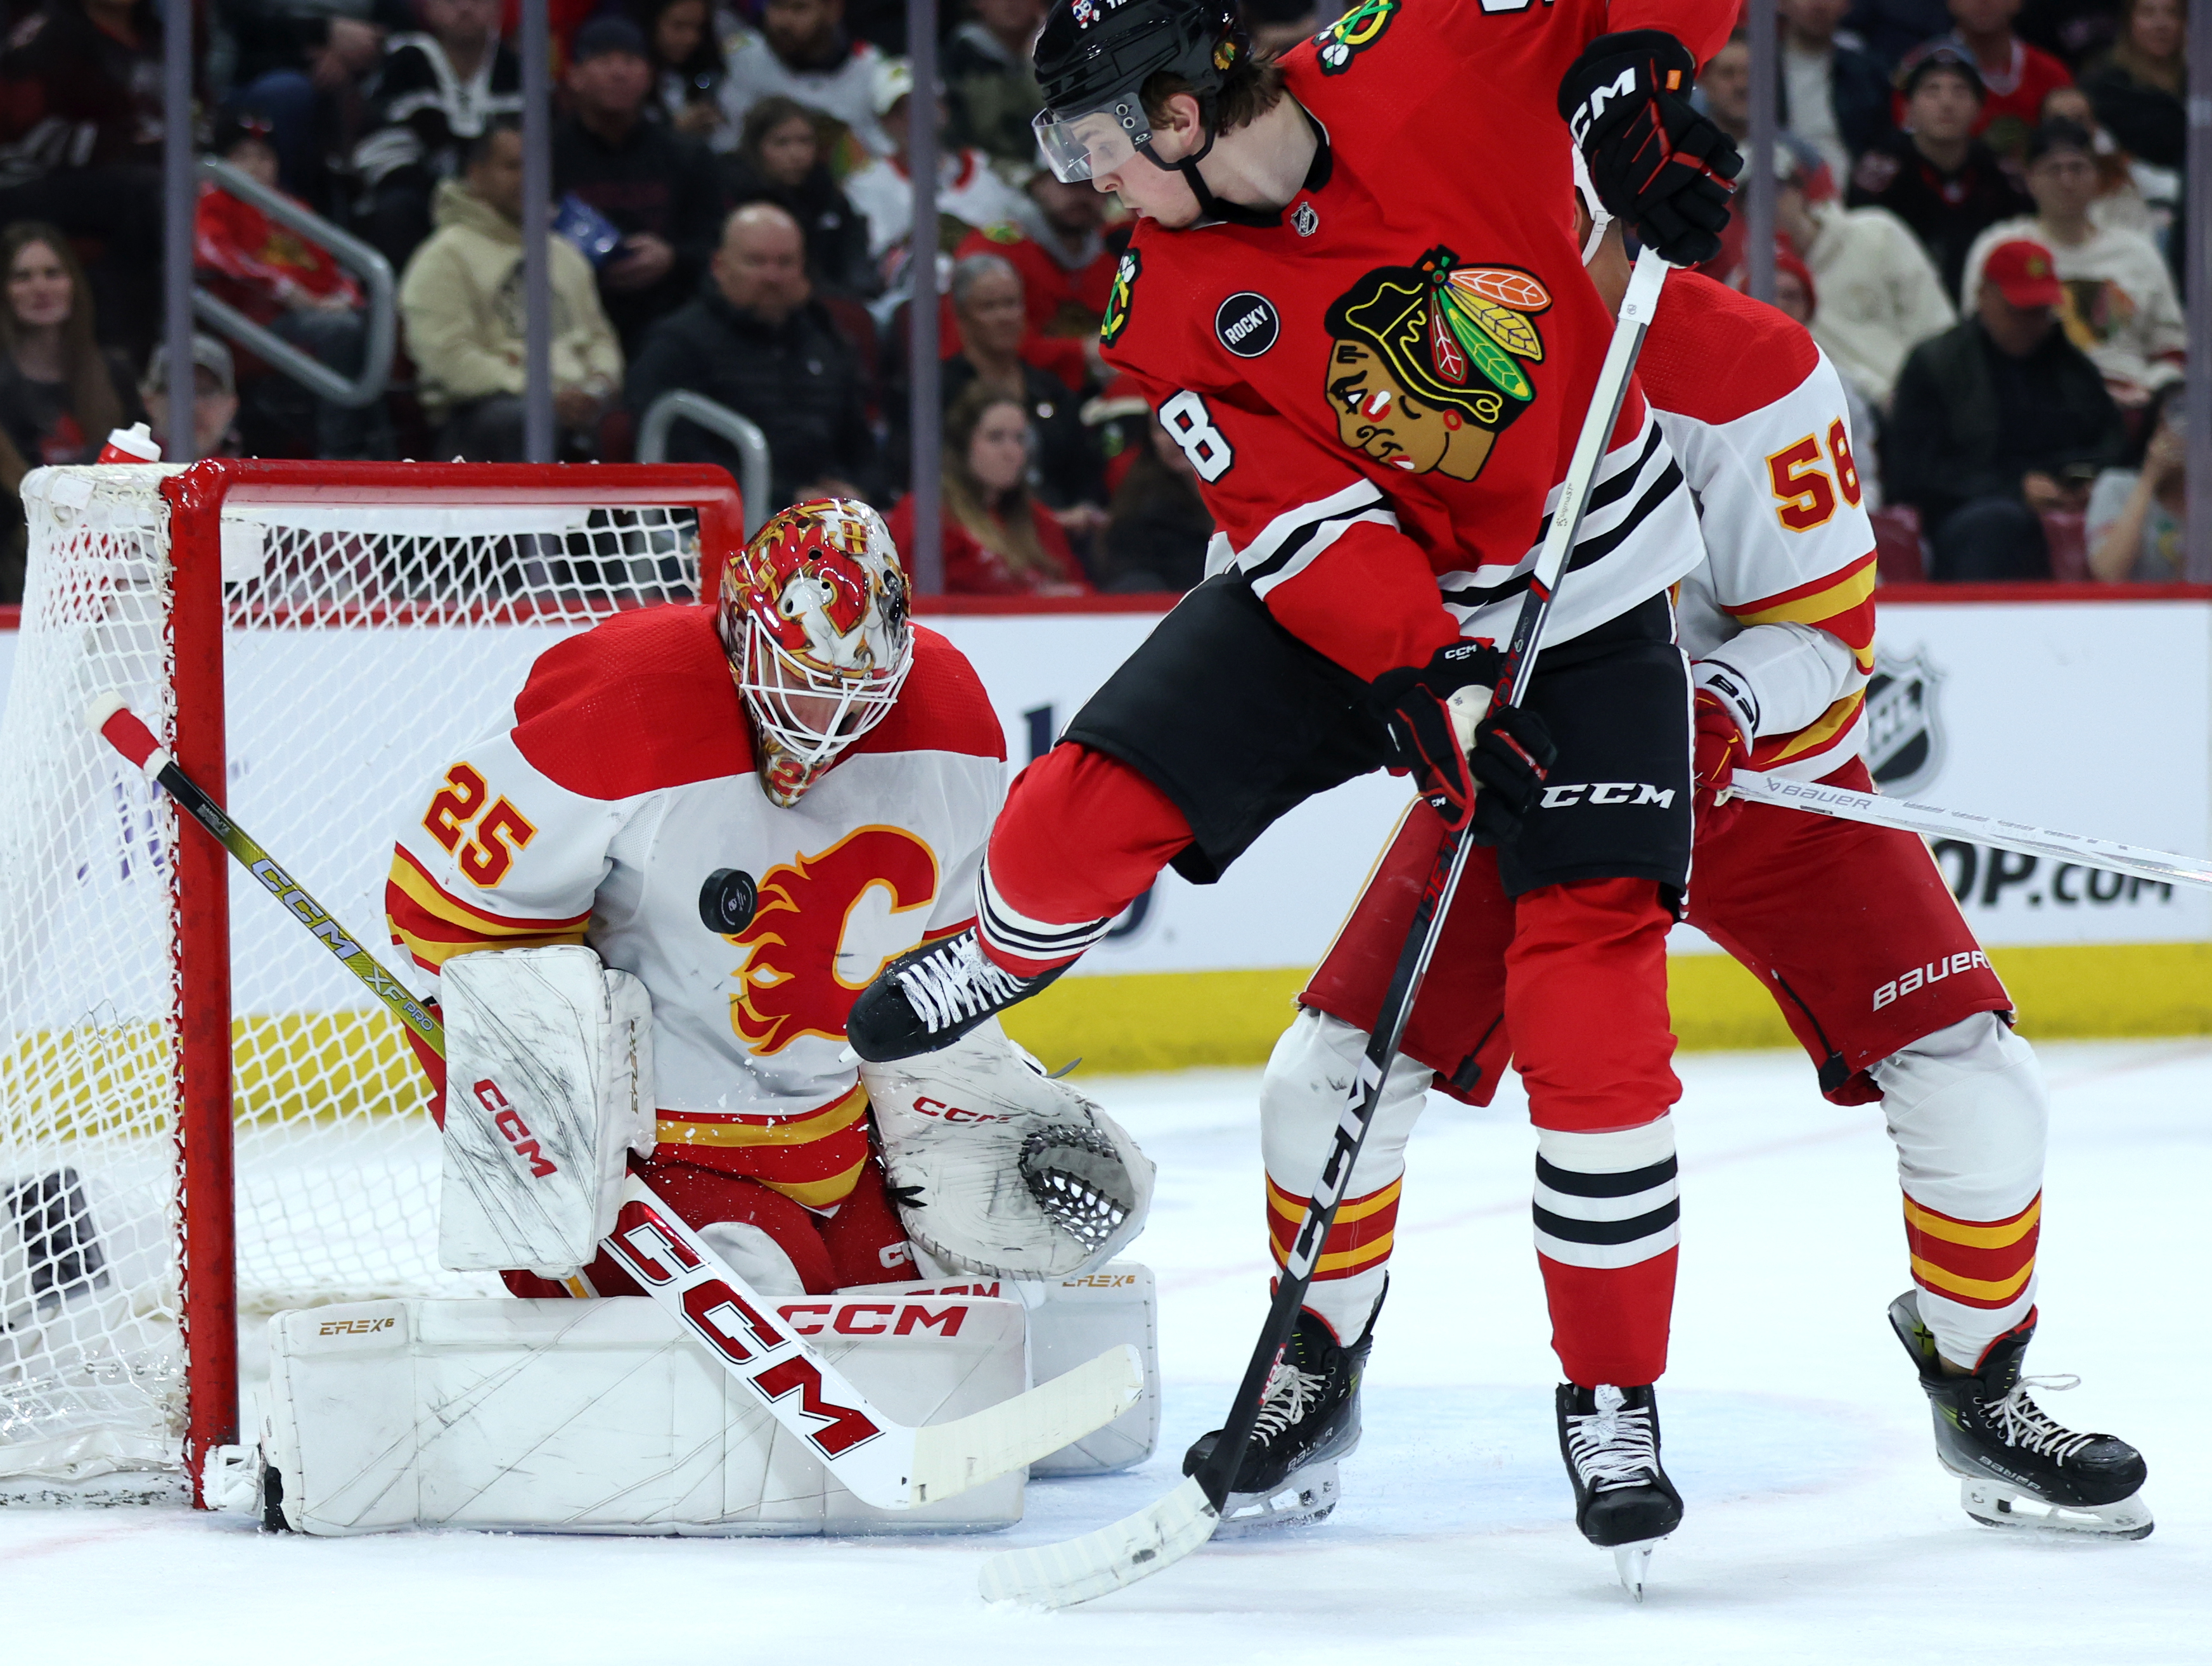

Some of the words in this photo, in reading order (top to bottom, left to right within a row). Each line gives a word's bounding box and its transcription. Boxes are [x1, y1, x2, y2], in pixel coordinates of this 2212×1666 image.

[1224, 305, 1268, 345] ROCKY
[1157, 388, 1236, 486] 8
[1444, 644, 1477, 660] CCM
[421, 760, 539, 890] 25
[1539, 783, 1676, 809] CCM
[251, 859, 362, 961] CCM
[363, 964, 408, 1001] XF
[402, 1000, 434, 1031] PRO
[473, 1079, 558, 1178] CCM
[1286, 1053, 1383, 1281] CCM
[597, 1201, 886, 1461] CCM
[776, 1304, 969, 1337] CCM
